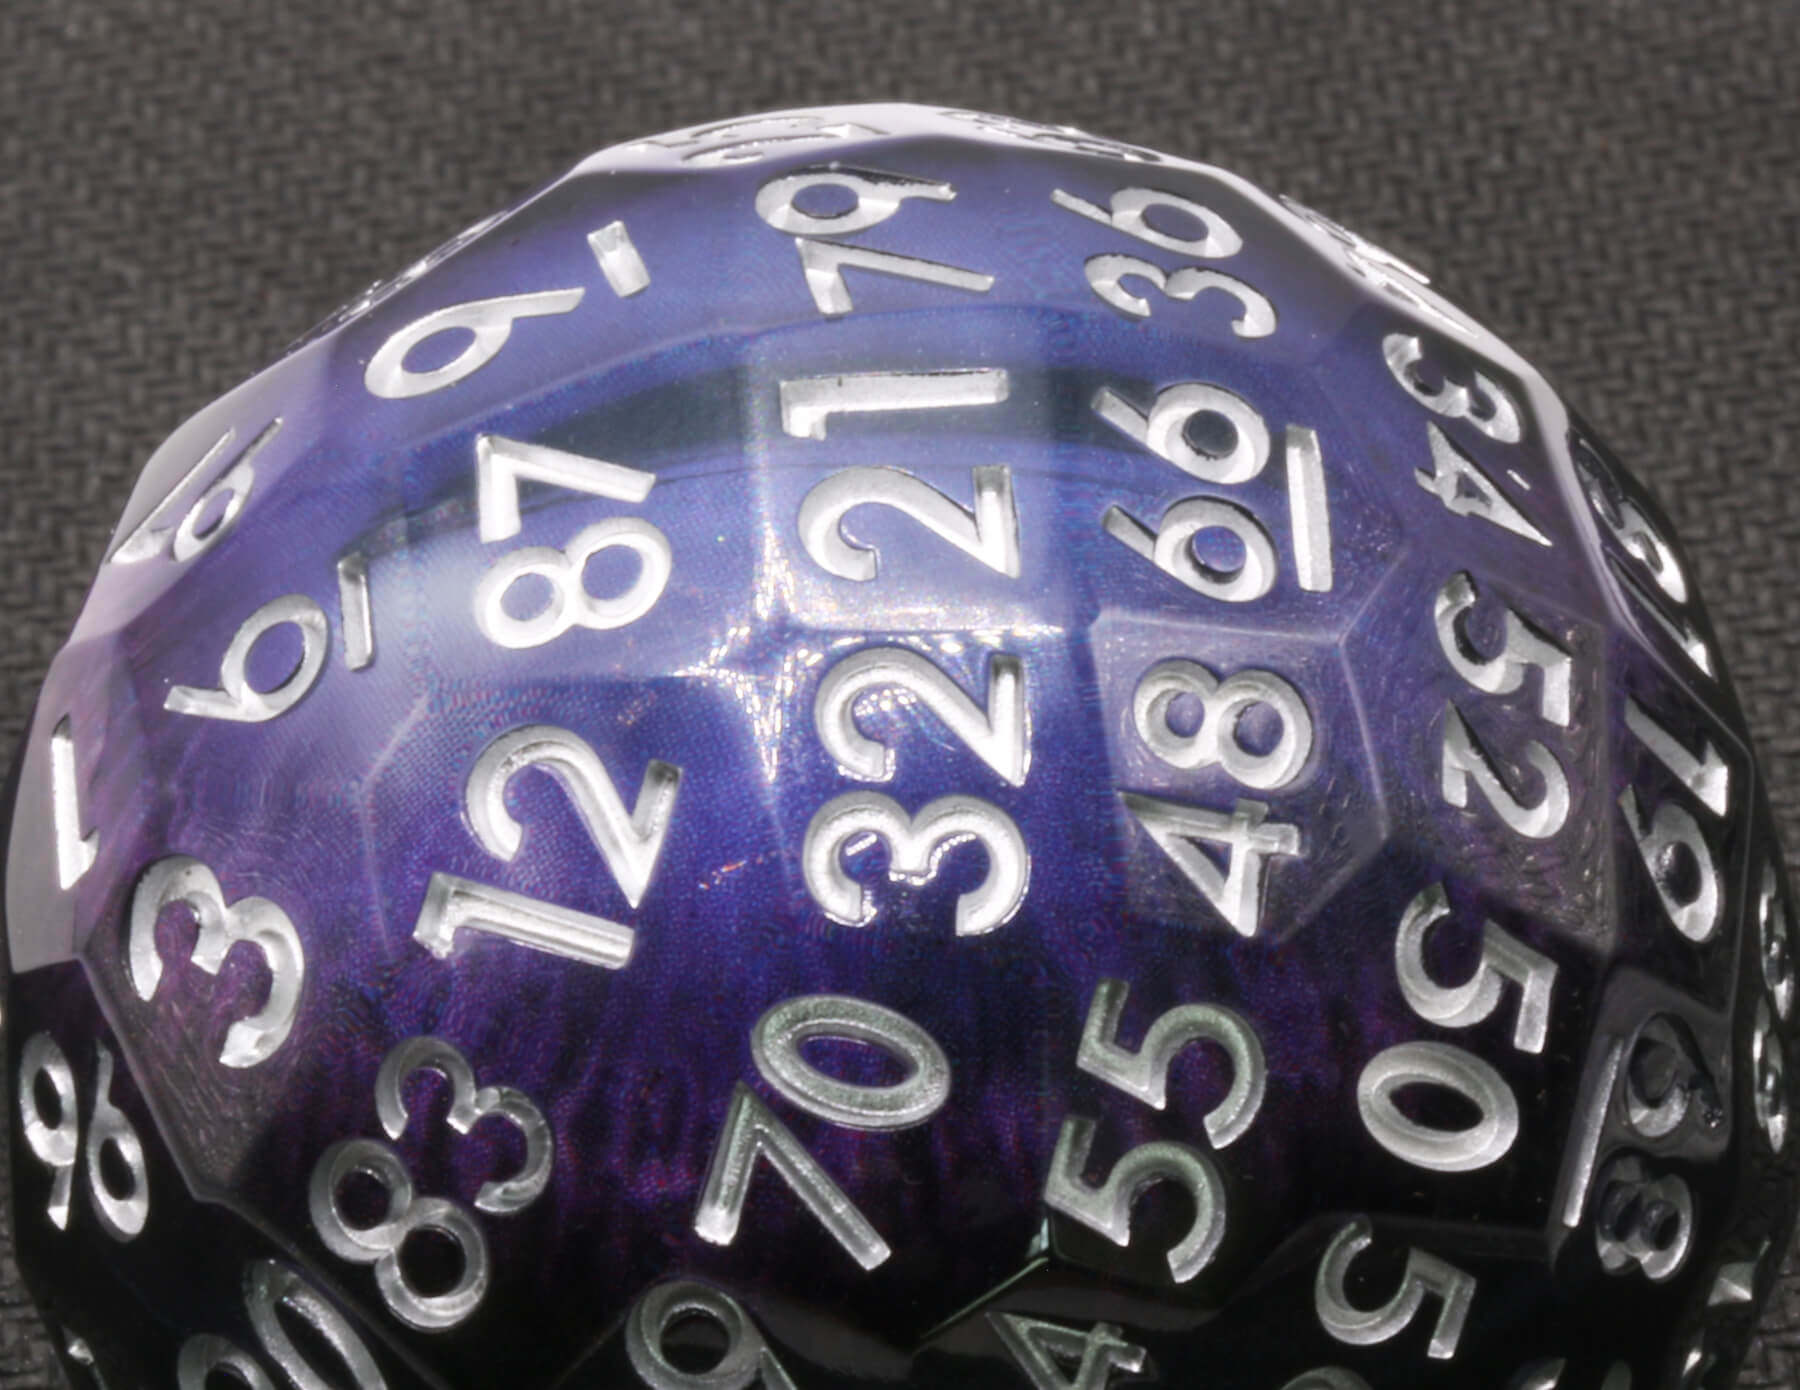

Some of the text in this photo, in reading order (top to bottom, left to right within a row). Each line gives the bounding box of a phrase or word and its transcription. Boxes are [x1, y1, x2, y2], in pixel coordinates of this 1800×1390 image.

[755, 163, 996, 316] 79
[1050, 187, 1277, 339] 36
[472, 432, 672, 650] 87
[779, 367, 1021, 581] 21
[1092, 381, 1280, 603] 66
[801, 645, 1032, 937] 32
[1116, 658, 1315, 938] 48
[1433, 569, 1574, 841] 52
[127, 854, 305, 1069] 3
[412, 724, 684, 970] 12
[18, 1030, 151, 1236] 96
[694, 994, 952, 1272] 70
[1045, 977, 1268, 1284] 55
[1356, 881, 1560, 1174] 50
[308, 1035, 555, 1332] 83
